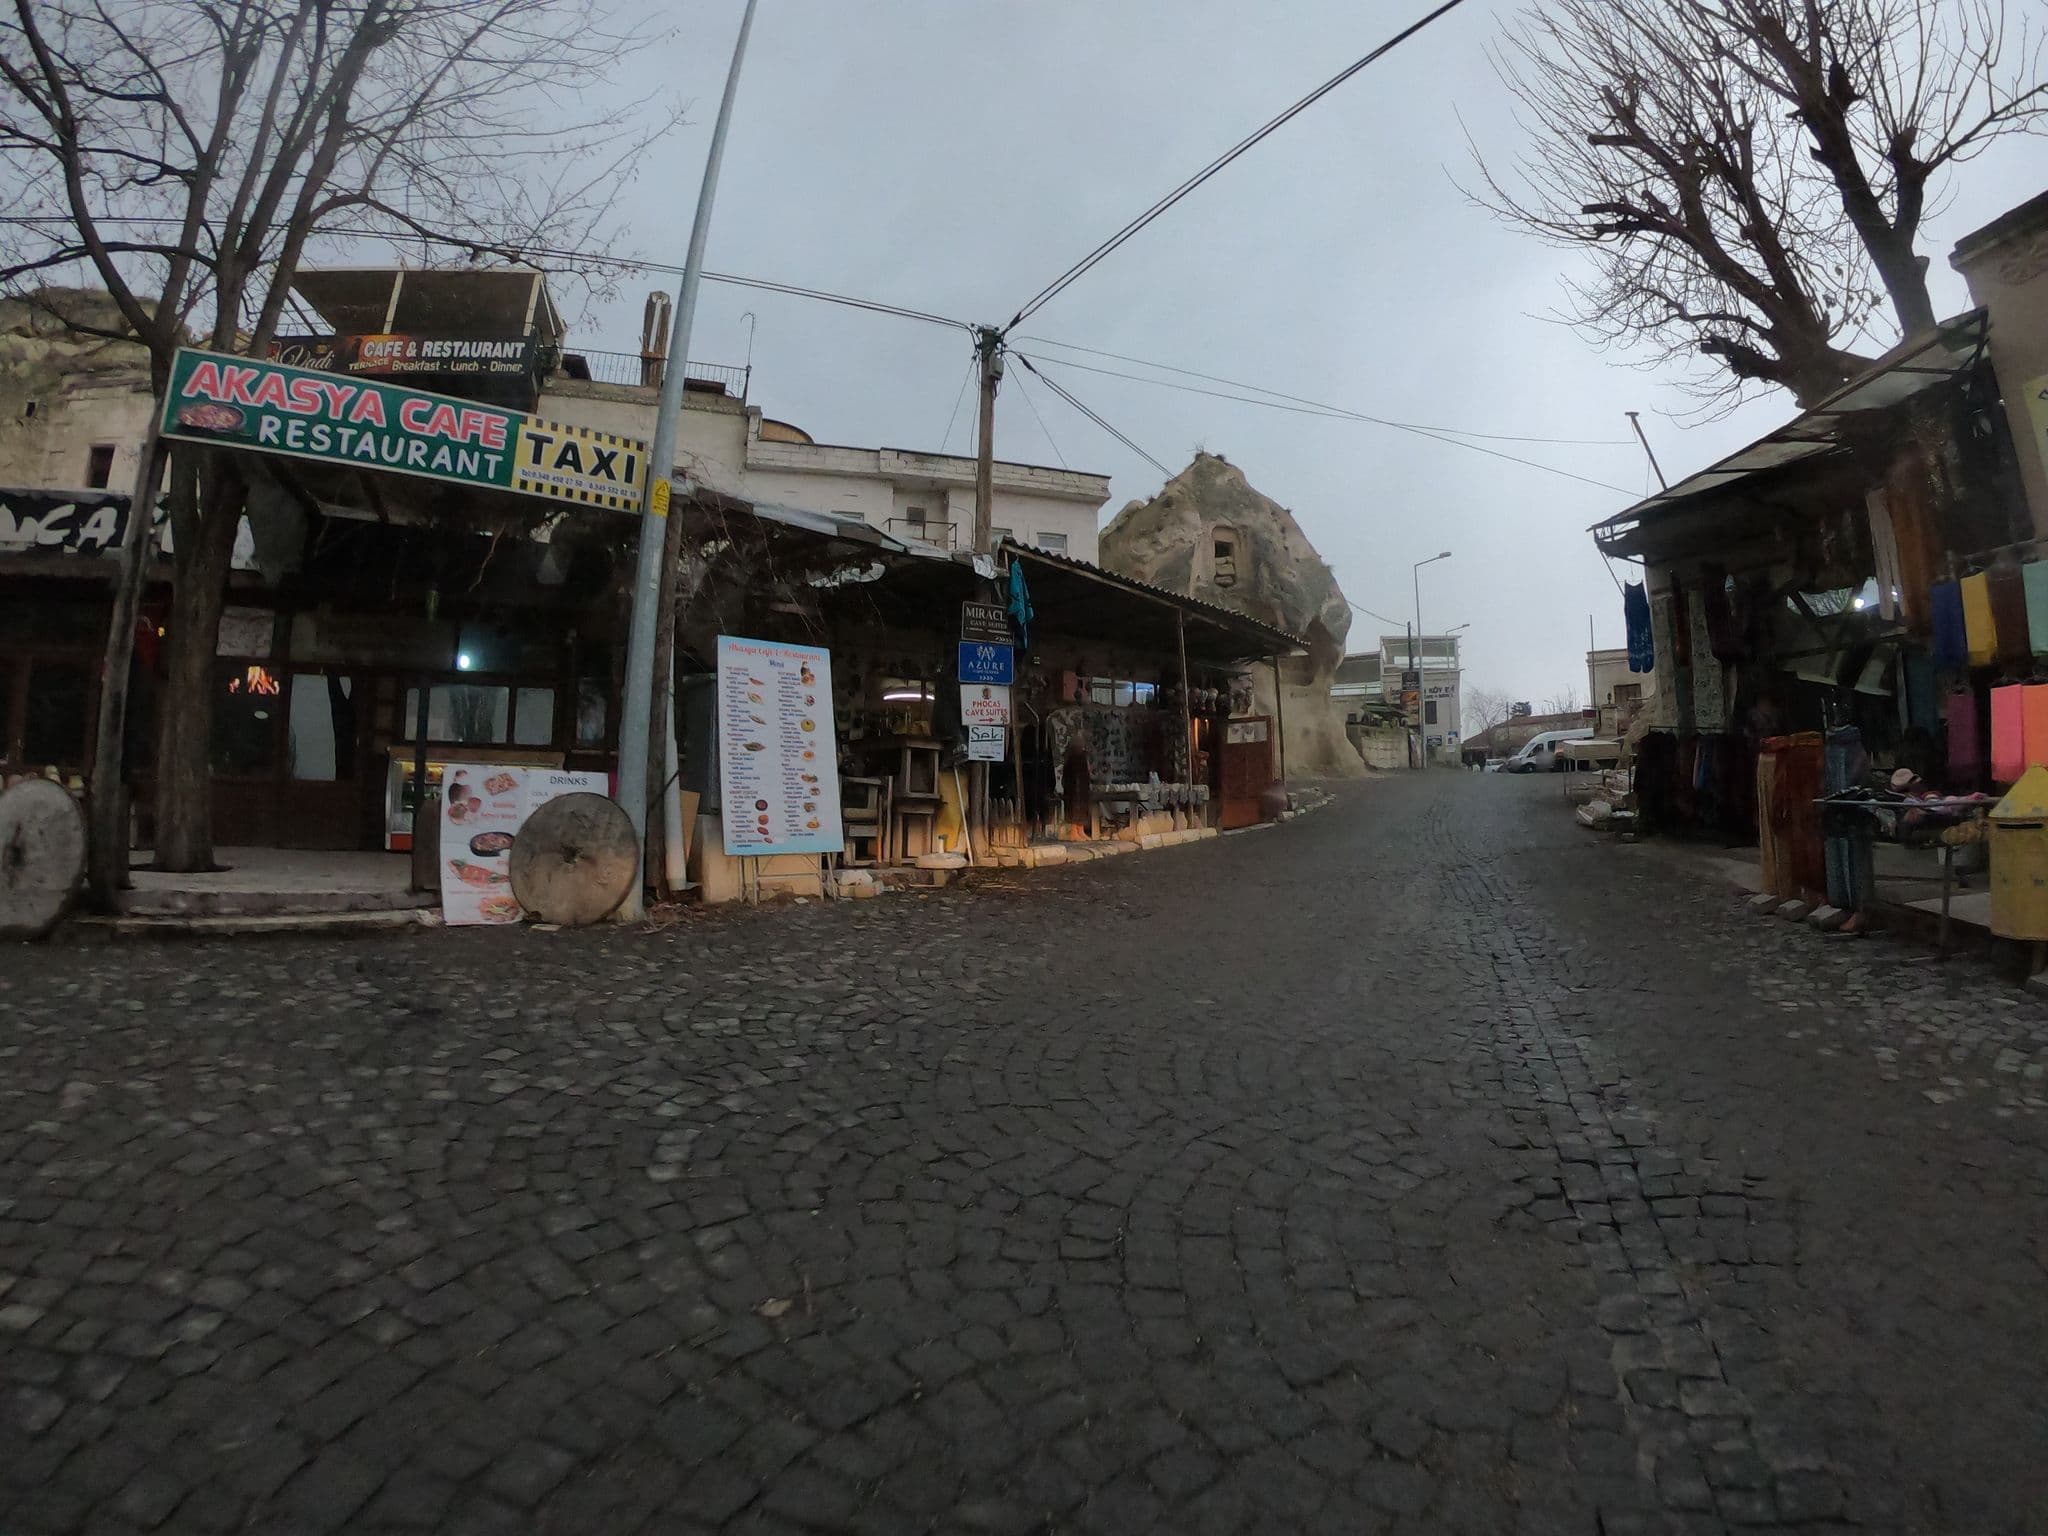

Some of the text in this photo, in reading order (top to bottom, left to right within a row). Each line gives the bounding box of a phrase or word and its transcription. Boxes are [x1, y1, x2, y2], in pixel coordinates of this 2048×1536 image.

[364, 340, 526, 359] CAFE & RESTAURANT
[392, 360, 440, 372] Breakfast
[450, 361, 479, 372] Lunch
[490, 361, 522, 372] Dinner
[182, 362, 508, 450] AKASYA CAFE
[259, 414, 504, 480] RESTAURANT
[525, 432, 636, 484] TAXI
[966, 607, 1008, 622] MIRACL
[968, 661, 1005, 671] AZURE
[986, 708, 1008, 716] SUITES
[550, 776, 588, 786] DRINKS
